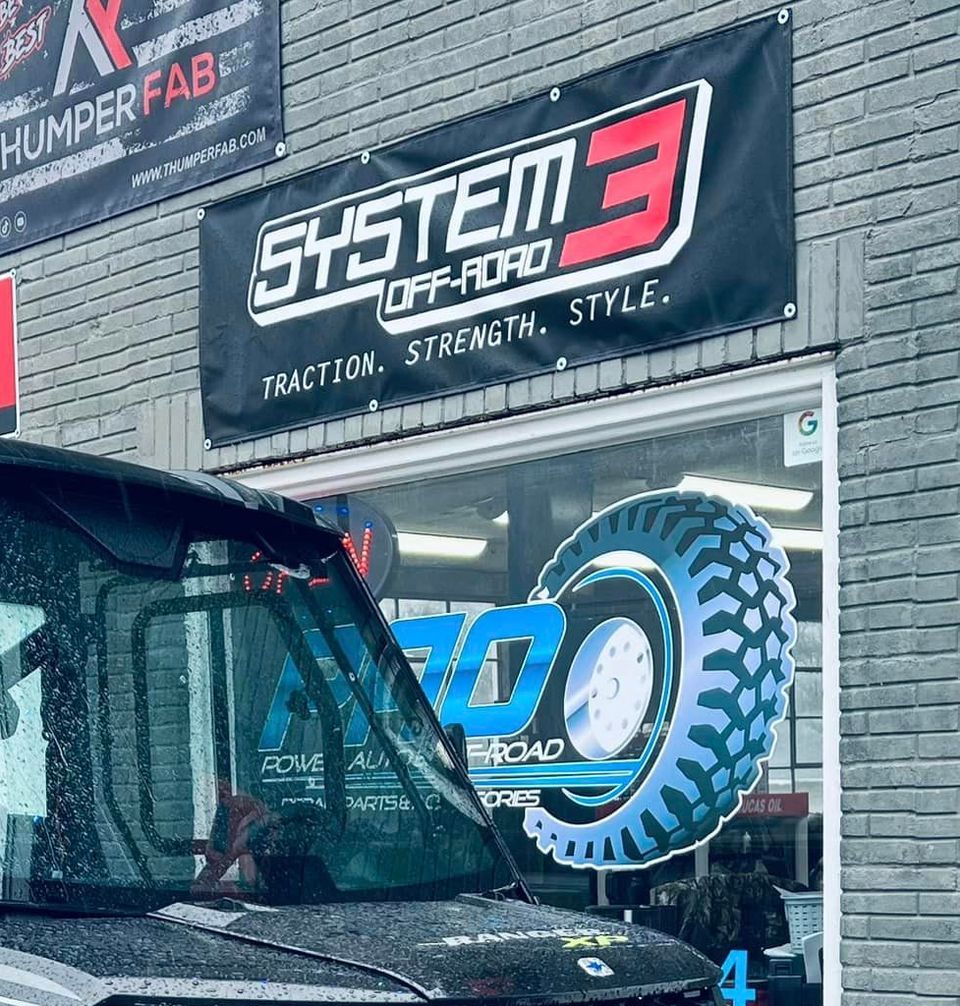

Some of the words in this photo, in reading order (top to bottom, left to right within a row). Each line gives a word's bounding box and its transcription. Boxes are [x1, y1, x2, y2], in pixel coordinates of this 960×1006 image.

[0, 9, 48, 73] BEST
[130, 126, 267, 190] WWW.THUMPERFAB.COM
[254, 138, 577, 307] SYSTEM
[557, 98, 687, 268] 3
[383, 238, 554, 314] OFF-ROAD
[261, 355, 386, 400] TRACTION.
[405, 315, 547, 366] STRENGTH.
[569, 279, 671, 326] STYLE.
[740, 799, 766, 814] UCAS
